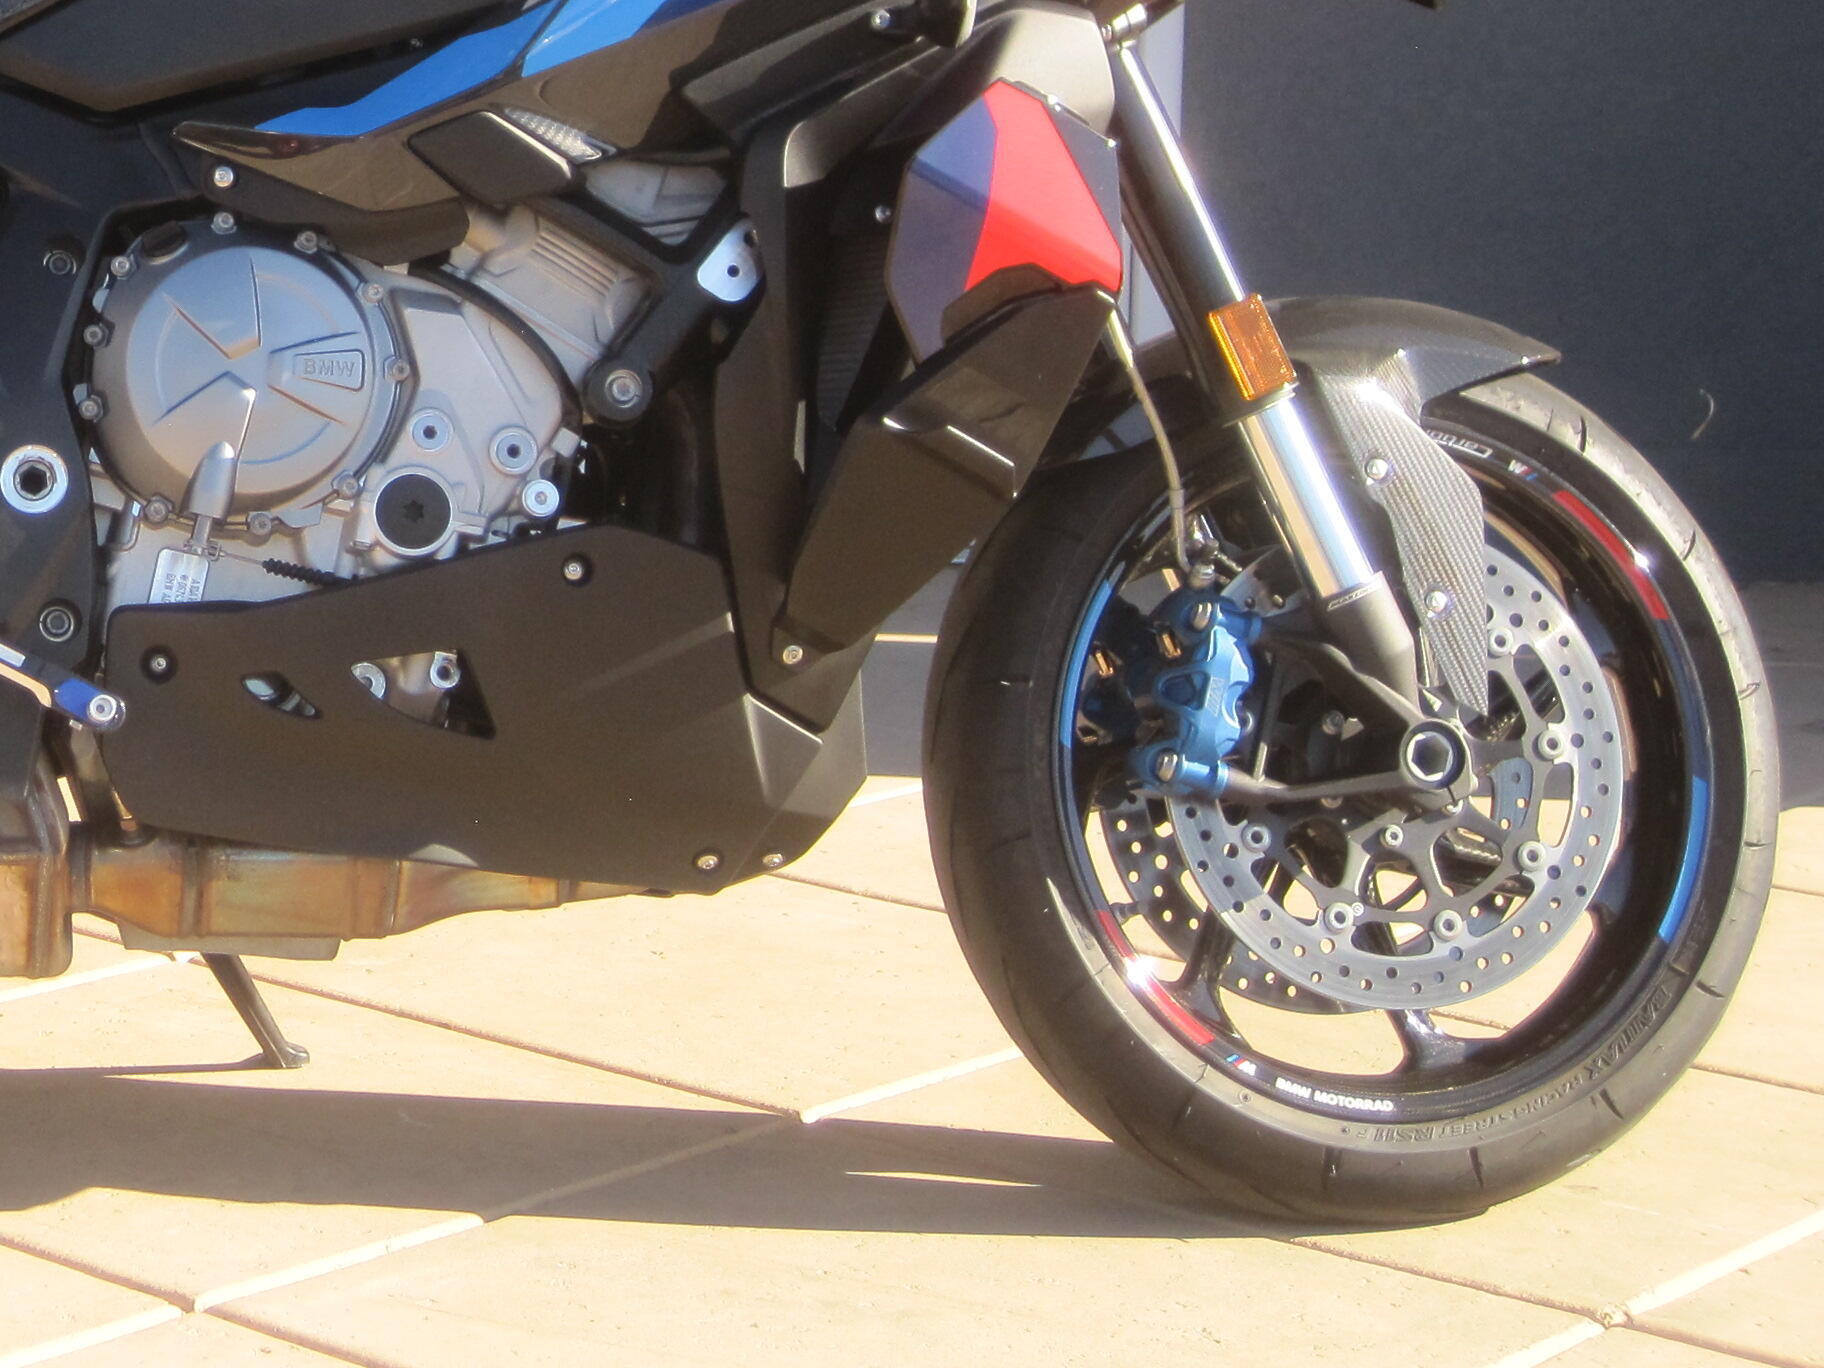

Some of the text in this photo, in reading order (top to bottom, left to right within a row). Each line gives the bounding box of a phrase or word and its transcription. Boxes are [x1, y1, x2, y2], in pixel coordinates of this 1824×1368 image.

[303, 358, 356, 378] BMW
[1275, 1077, 1312, 1099] BMW
[1313, 1090, 1394, 1112] MOTORRAD
